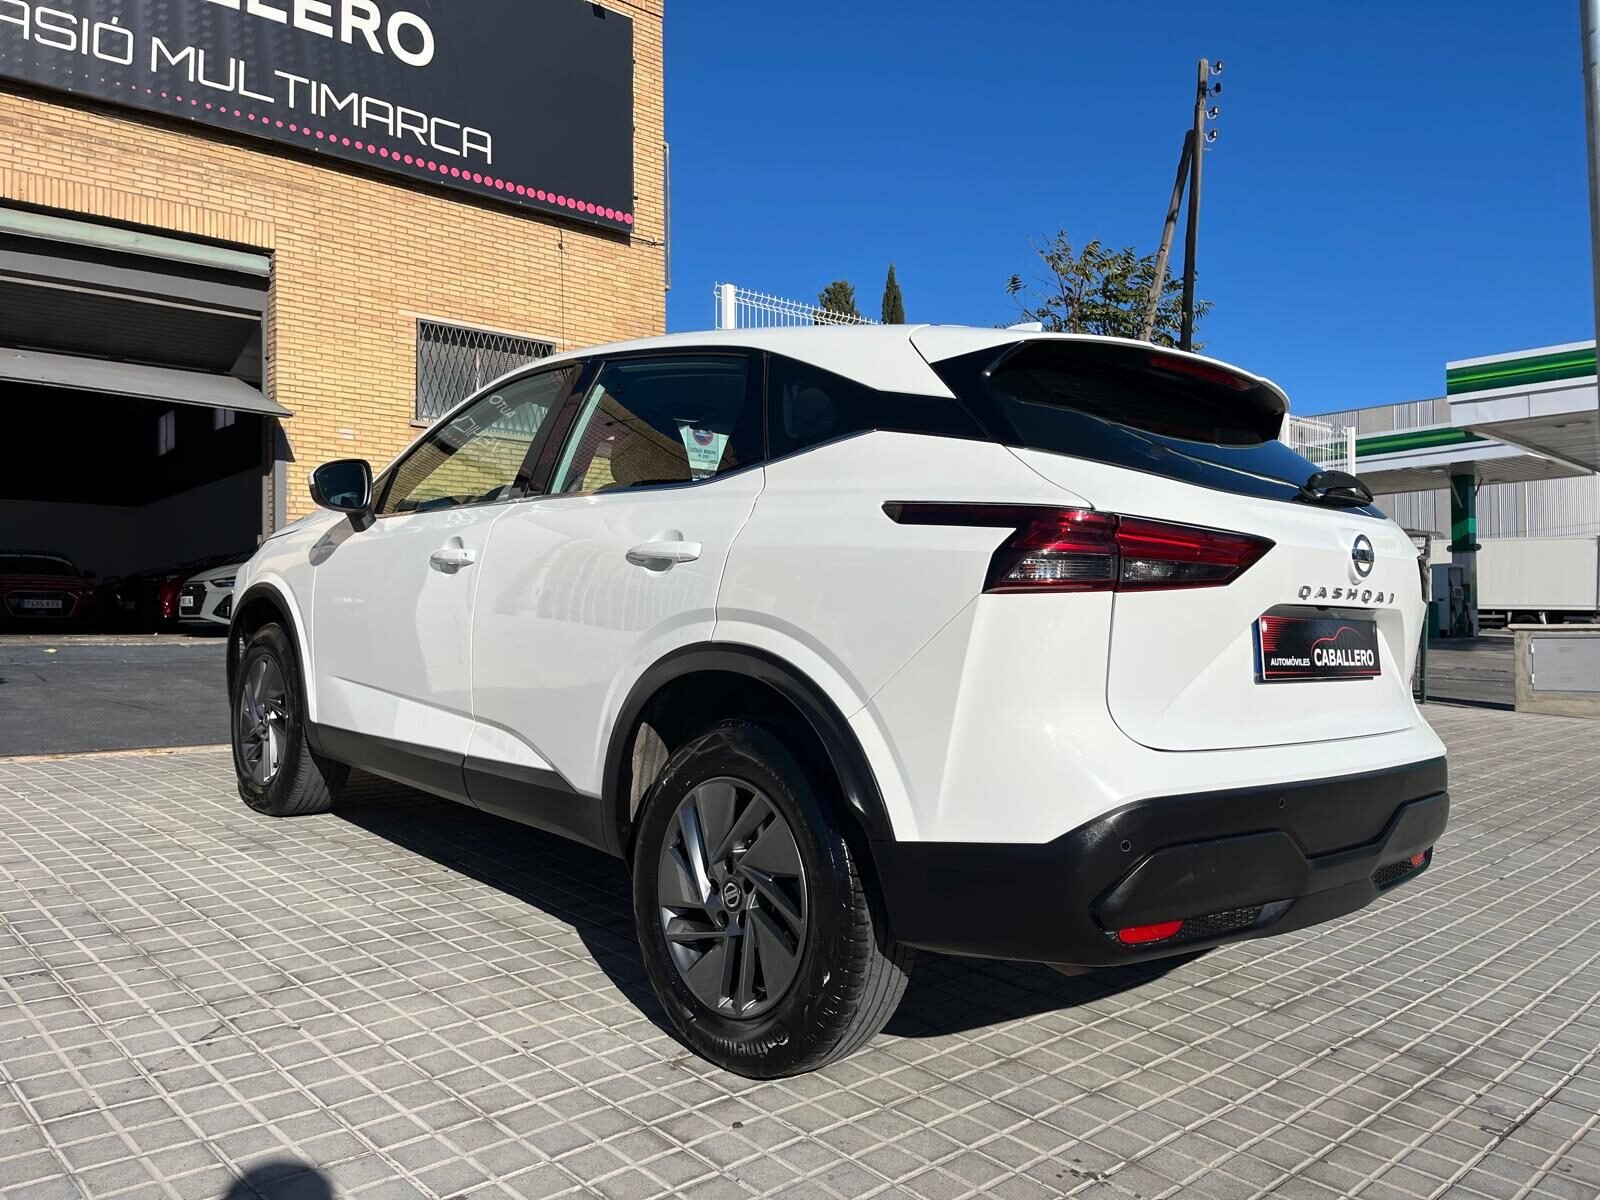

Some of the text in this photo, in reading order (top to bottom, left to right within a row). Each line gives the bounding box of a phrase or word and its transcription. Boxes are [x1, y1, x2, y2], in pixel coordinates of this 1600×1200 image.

[206, 0, 434, 66] ERO
[151, 36, 491, 166] MULTIMARCA
[1298, 585, 1394, 604] QASHQAI
[1270, 648, 1375, 667] AUTOMÓVILES CABALLERO
